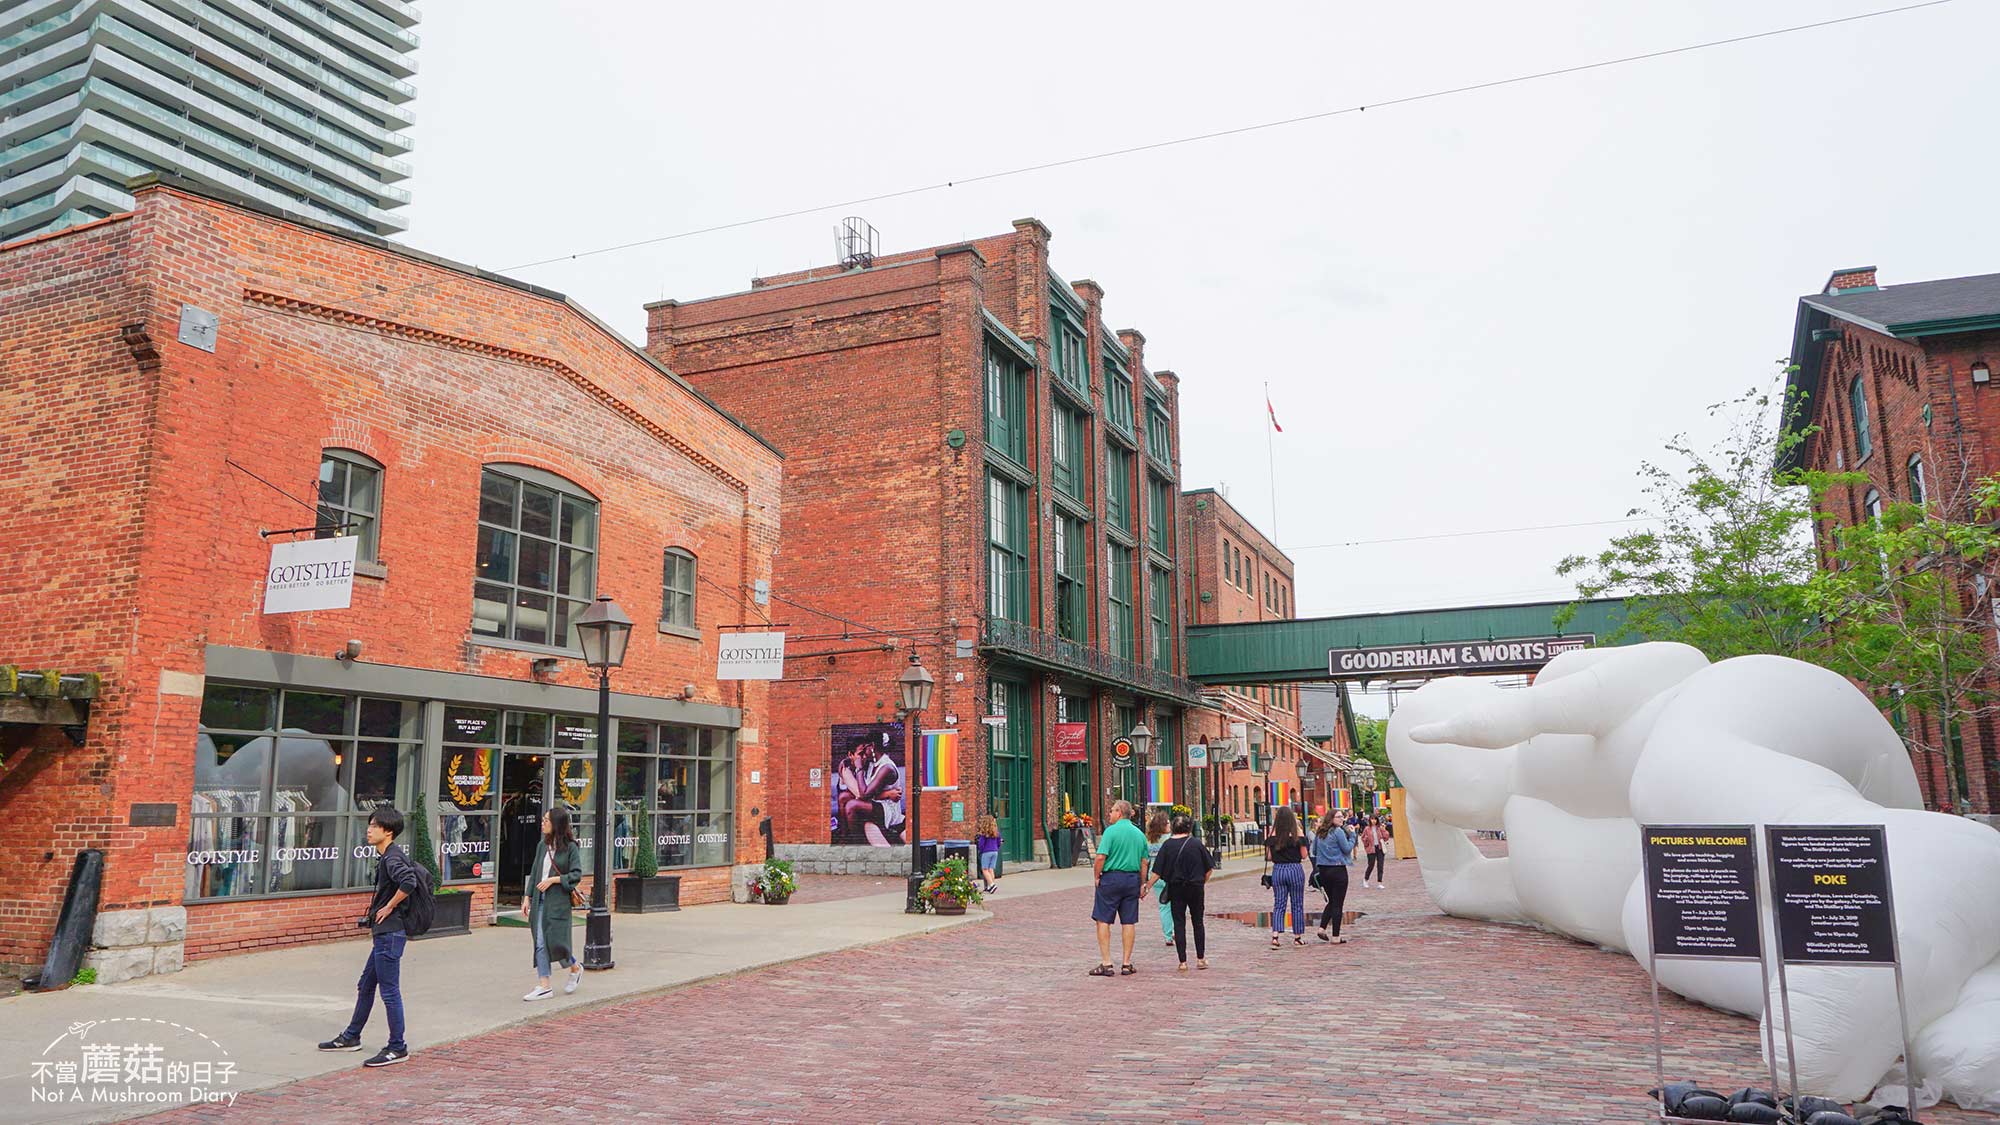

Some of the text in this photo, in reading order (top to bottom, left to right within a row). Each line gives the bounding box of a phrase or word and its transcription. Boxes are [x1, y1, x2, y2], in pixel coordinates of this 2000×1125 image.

[270, 560, 351, 583] GOTSTYLE
[720, 648, 782, 660] GOTSTYLE
[1340, 648, 1456, 670] GOODERHAM
[1461, 646, 1477, 663] &
[1477, 642, 1545, 661] WORTS
[658, 834, 691, 845] GOTSTYLE
[697, 833, 727, 843] GOTSTYLE
[1650, 837, 1747, 846] PICTURES WELCOME!
[441, 841, 490, 854] GOTSTYLE
[187, 850, 259, 865] GOTSTYLE
[276, 847, 339, 861] GOTSTYLE
[1813, 875, 1847, 885] POKE
